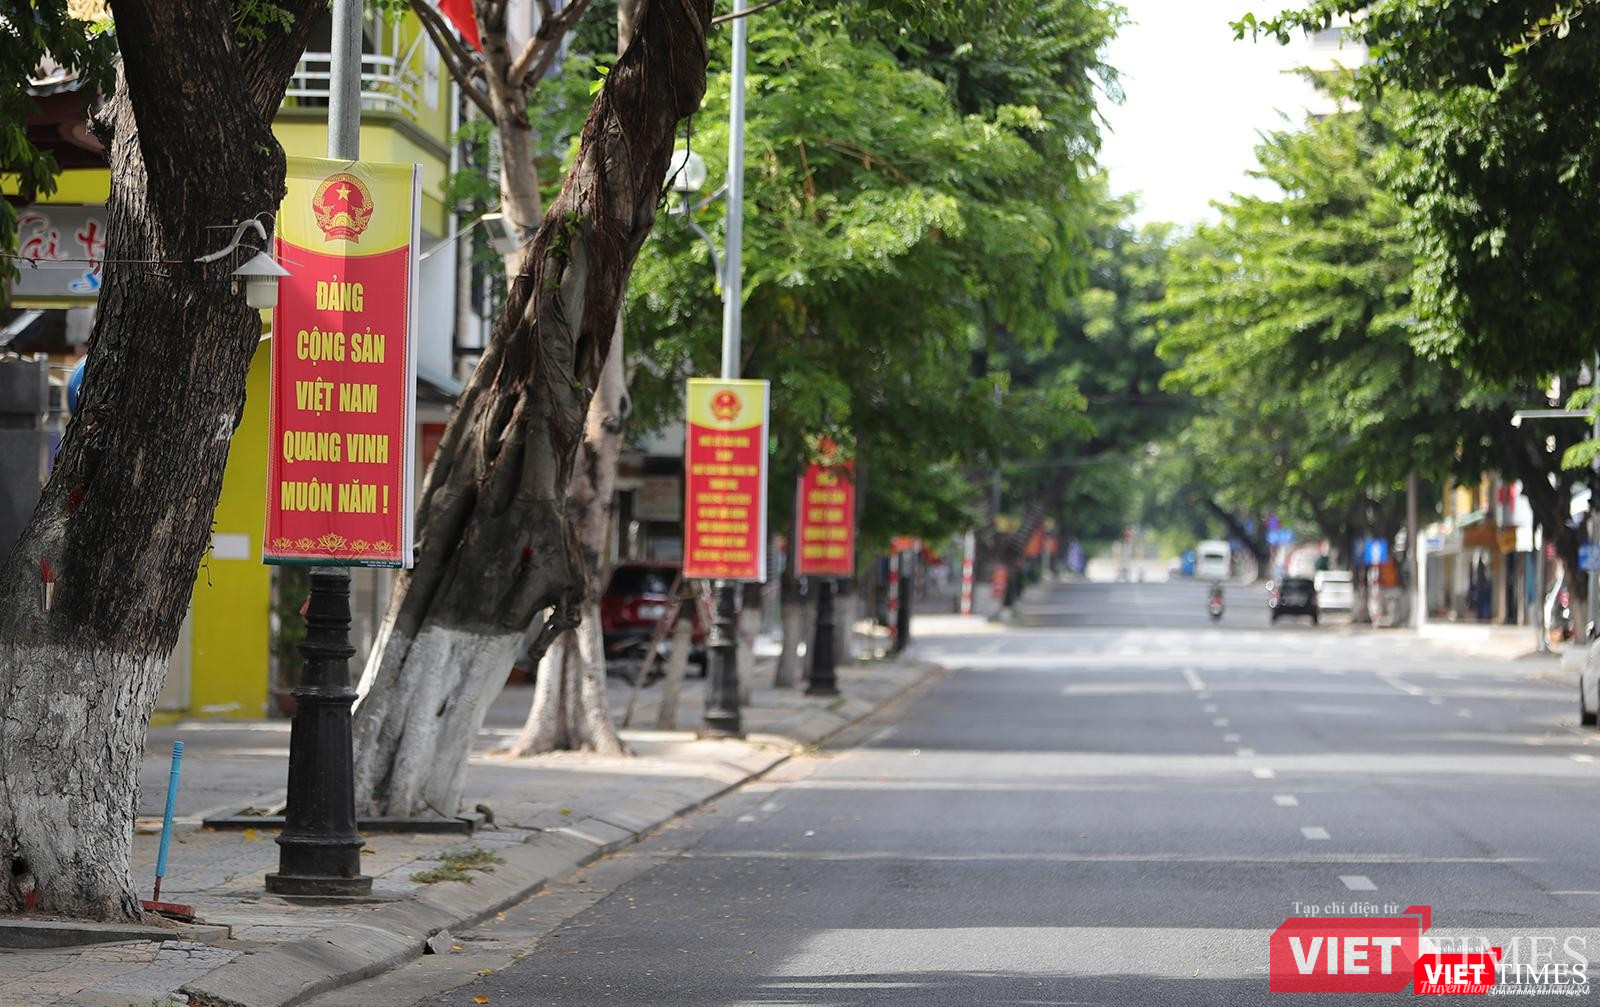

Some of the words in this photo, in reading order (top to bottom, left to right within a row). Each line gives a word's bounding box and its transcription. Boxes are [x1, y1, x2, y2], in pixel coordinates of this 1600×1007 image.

[316, 274, 364, 313] ĐẢNG
[297, 326, 346, 366] CỘNG
[351, 326, 385, 364] SẢN
[295, 376, 335, 417] VIỆT
[339, 383, 378, 413] NAM
[283, 430, 341, 464] QUANG
[346, 433, 389, 464] VINH
[281, 476, 333, 512] MUÔN
[338, 478, 377, 514] NĂM
